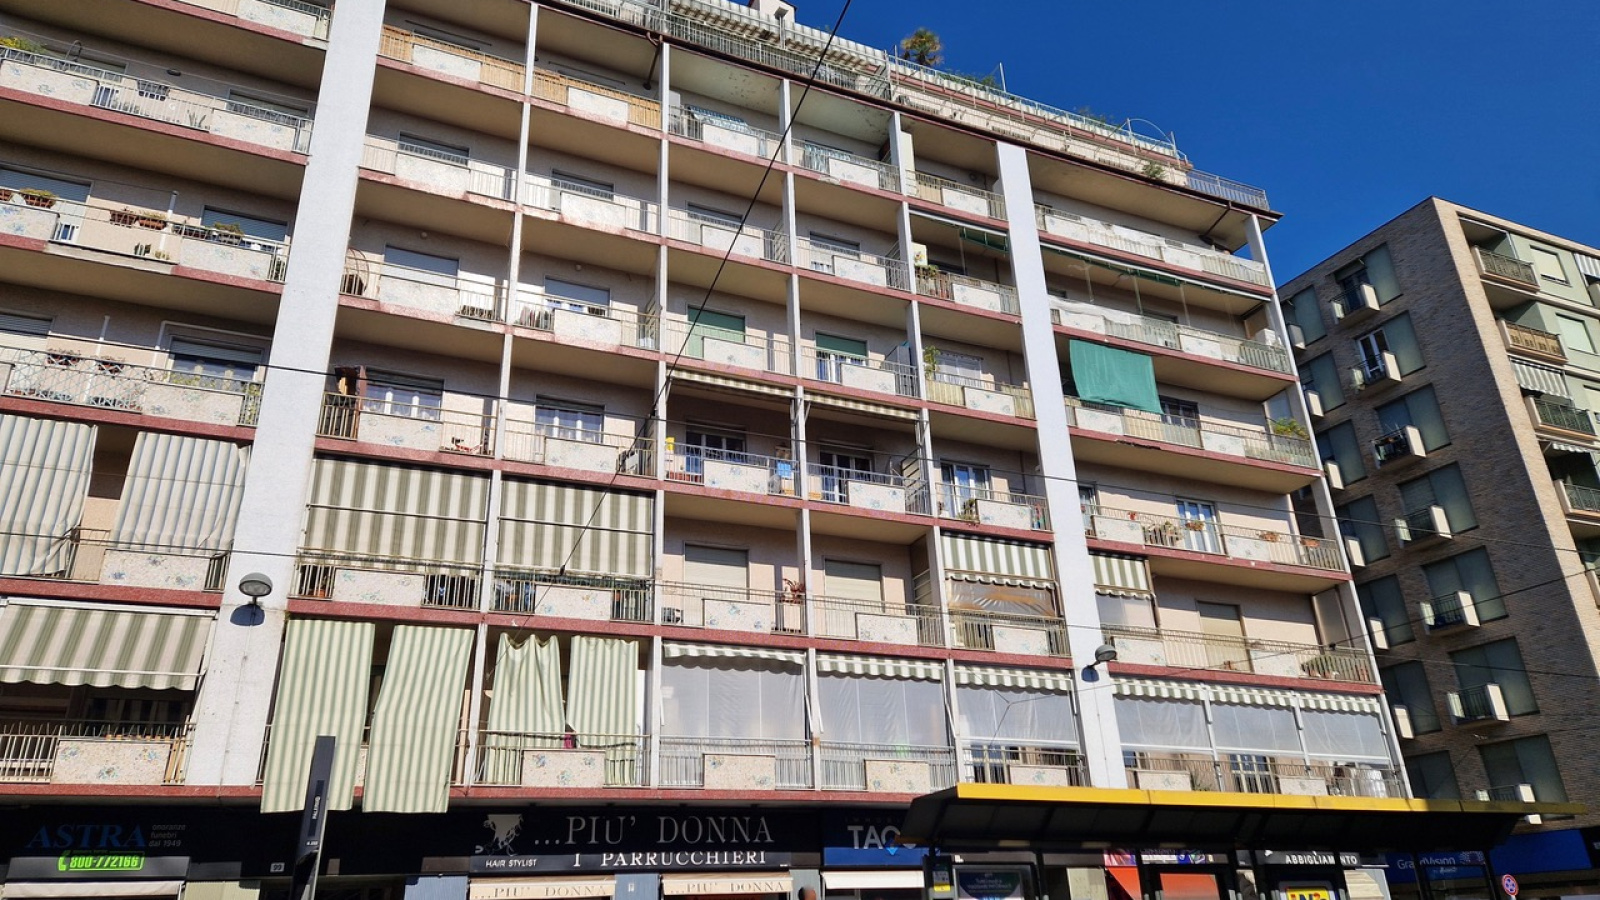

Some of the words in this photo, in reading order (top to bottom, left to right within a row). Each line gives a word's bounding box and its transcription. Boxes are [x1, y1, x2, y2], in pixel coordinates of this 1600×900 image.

[656, 815, 775, 844] DONNA
[24, 824, 148, 848] ASTRA
[148, 839, 161, 847] dal
[163, 839, 182, 847] 1949
[485, 859, 506, 868] HAIR
[508, 858, 538, 868] STYLIST
[572, 853, 582, 867] I
[600, 850, 767, 867] PARRUCCHIERI
[1285, 854, 1358, 865] ABBIGLIAMNTO
[544, 885, 608, 897] DONNA
[730, 880, 786, 892] DONNA
